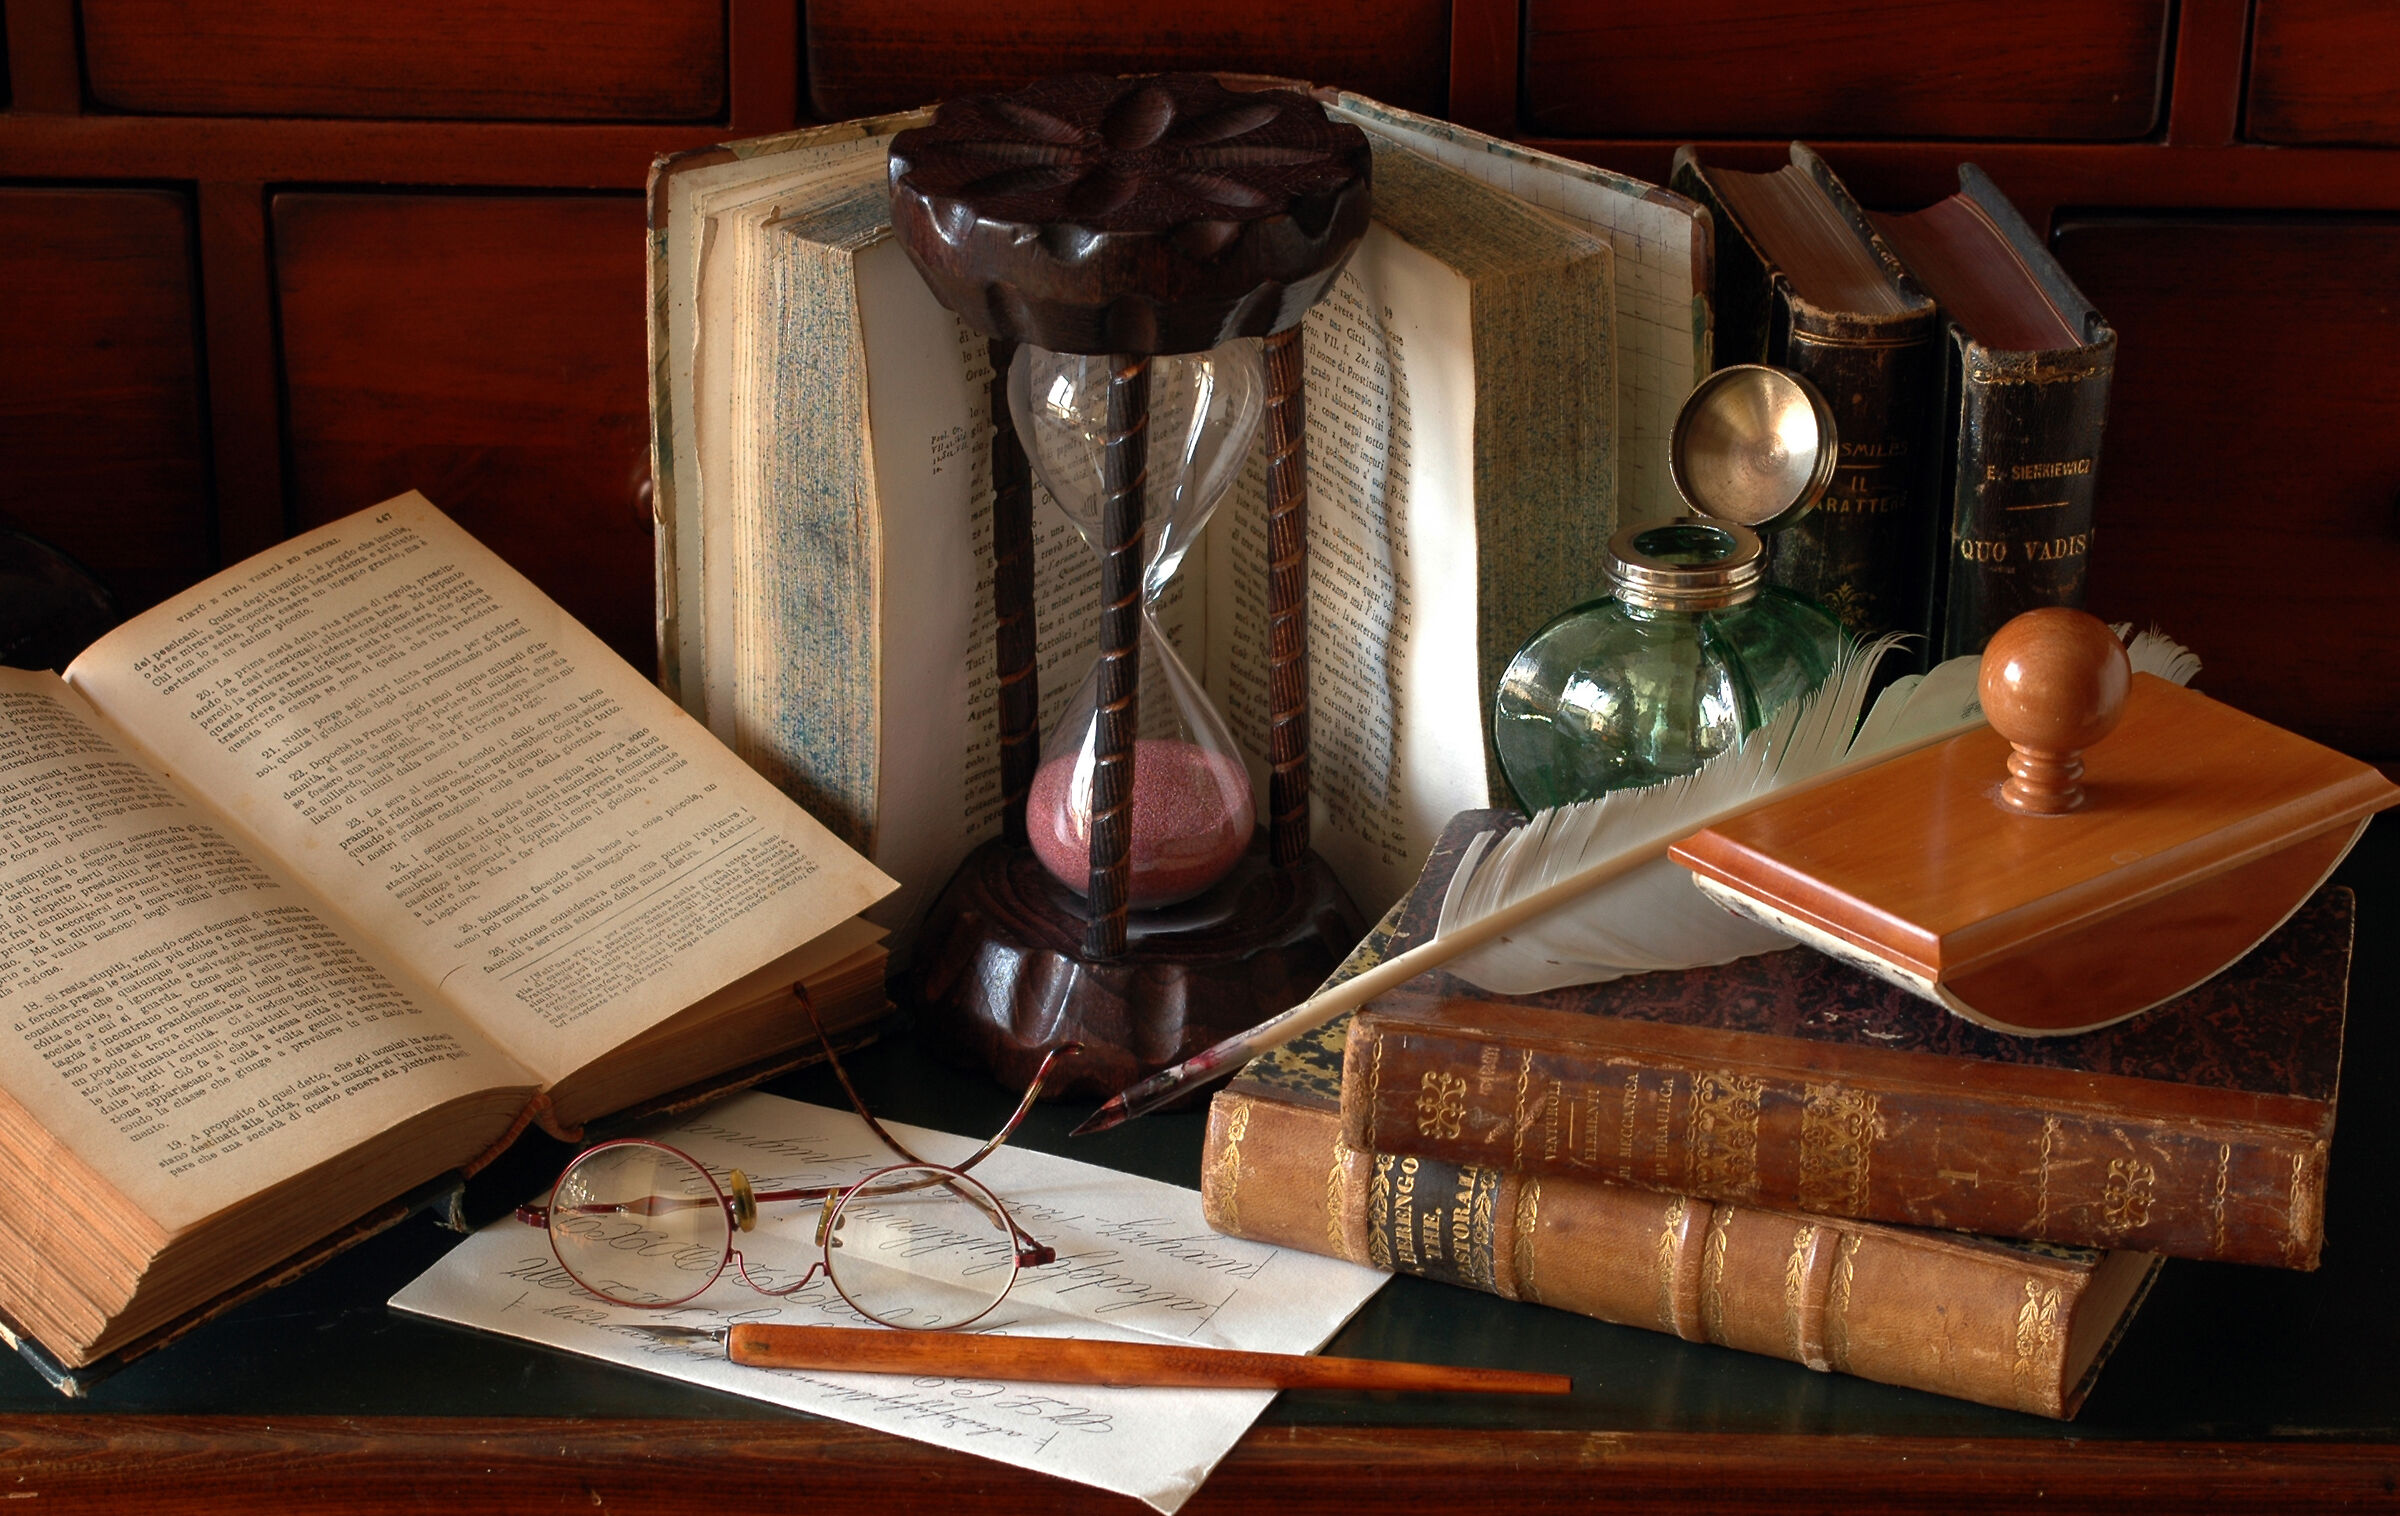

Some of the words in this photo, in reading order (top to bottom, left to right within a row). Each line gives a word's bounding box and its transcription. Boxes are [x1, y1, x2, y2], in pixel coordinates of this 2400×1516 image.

[1851, 475, 1868, 492] IL
[1987, 464, 2000, 480] E.
[2011, 458, 2092, 480] SIENKIEWICZ
[1960, 538, 2008, 562] QUO
[156, 658, 219, 695] certamente
[222, 648, 236, 657] un
[240, 629, 271, 648] animo
[275, 609, 313, 631] piccolo.
[256, 764, 277, 777] noi,
[277, 740, 312, 764] quanta
[320, 716, 353, 739] giudizi
[354, 708, 372, 719] che
[374, 693, 397, 708] degli
[398, 682, 421, 695] altri
[422, 648, 483, 685] pronunziamo
[484, 639, 500, 652] noi
[501, 627, 530, 643] stessi.
[262, 748, 280, 758] 21.
[282, 728, 311, 746] Nulla
[313, 711, 343, 728] porge
[368, 684, 391, 698] altri
[393, 671, 420, 684] tanta
[424, 650, 461, 670] materia
[464, 639, 479, 651] per
[482, 619, 520, 641] giudicar
[284, 774, 326, 800] dennità,
[327, 764, 338, 773] si
[381, 729, 403, 743] ogni
[406, 717, 429, 732] poco
[432, 696, 468, 718] parlare
[471, 687, 482, 696] di
[487, 665, 529, 688] miliardi,
[534, 650, 558, 663] come
[289, 769, 308, 781] 22.
[350, 738, 363, 746] la
[362, 719, 400, 740] Francia
[432, 690, 452, 704] suoi
[456, 673, 487, 692] cinque
[488, 651, 526, 675] miliardi
[293, 800, 304, 809] se
[308, 776, 343, 799] fossero
[346, 764, 365, 776] una
[427, 723, 444, 732] Ma
[447, 711, 463, 724] per
[468, 678, 527, 711] comprendere
[533, 667, 549, 677] che
[310, 804, 342, 824] liardo
[345, 794, 357, 804] di
[360, 774, 393, 796] minuti
[396, 761, 421, 776] dalla
[424, 742, 459, 762] nascita
[462, 732, 473, 741] di
[475, 716, 505, 733] Cristo
[508, 706, 520, 717] ad
[523, 695, 547, 709] oggi.
[105, 1081, 135, 1098] idee,
[137, 1066, 165, 1082] tutti
[179, 1038, 227, 1063] costumi,
[231, 1007, 290, 1039] combattuti
[167, 1140, 186, 1150] 19.
[203, 1107, 255, 1137] proposito
[258, 1098, 270, 1108] di
[272, 1085, 296, 1102] quel
[297, 1073, 331, 1089] detto,
[334, 1062, 353, 1072] che
[355, 1053, 371, 1065] gli
[372, 1039, 409, 1058] uomini
[159, 1153, 188, 1168] siano
[190, 1126, 240, 1153] destinati
[241, 1117, 264, 1130] alla
[265, 1102, 300, 1118] lotta,
[302, 1085, 330, 1100] ossia
[341, 1056, 394, 1083] mangiarsi
[392, 1047, 417, 1061] l'un
[170, 1163, 195, 1177] pare
[198, 1153, 217, 1164] che
[221, 1142, 243, 1153] una
[288, 1110, 301, 1121] di
[305, 1093, 340, 1113] questo
[345, 1077, 380, 1096] genere
[382, 1069, 398, 1079] sia
[1544, 1079, 1561, 1161] VENTUROLI
[1584, 1089, 1600, 1161] ELEMENTI
[1619, 1072, 1639, 1157] MECCANICA
[1655, 1076, 1674, 1158] IDRAULICA
[1393, 1157, 1420, 1264] BERENGO
